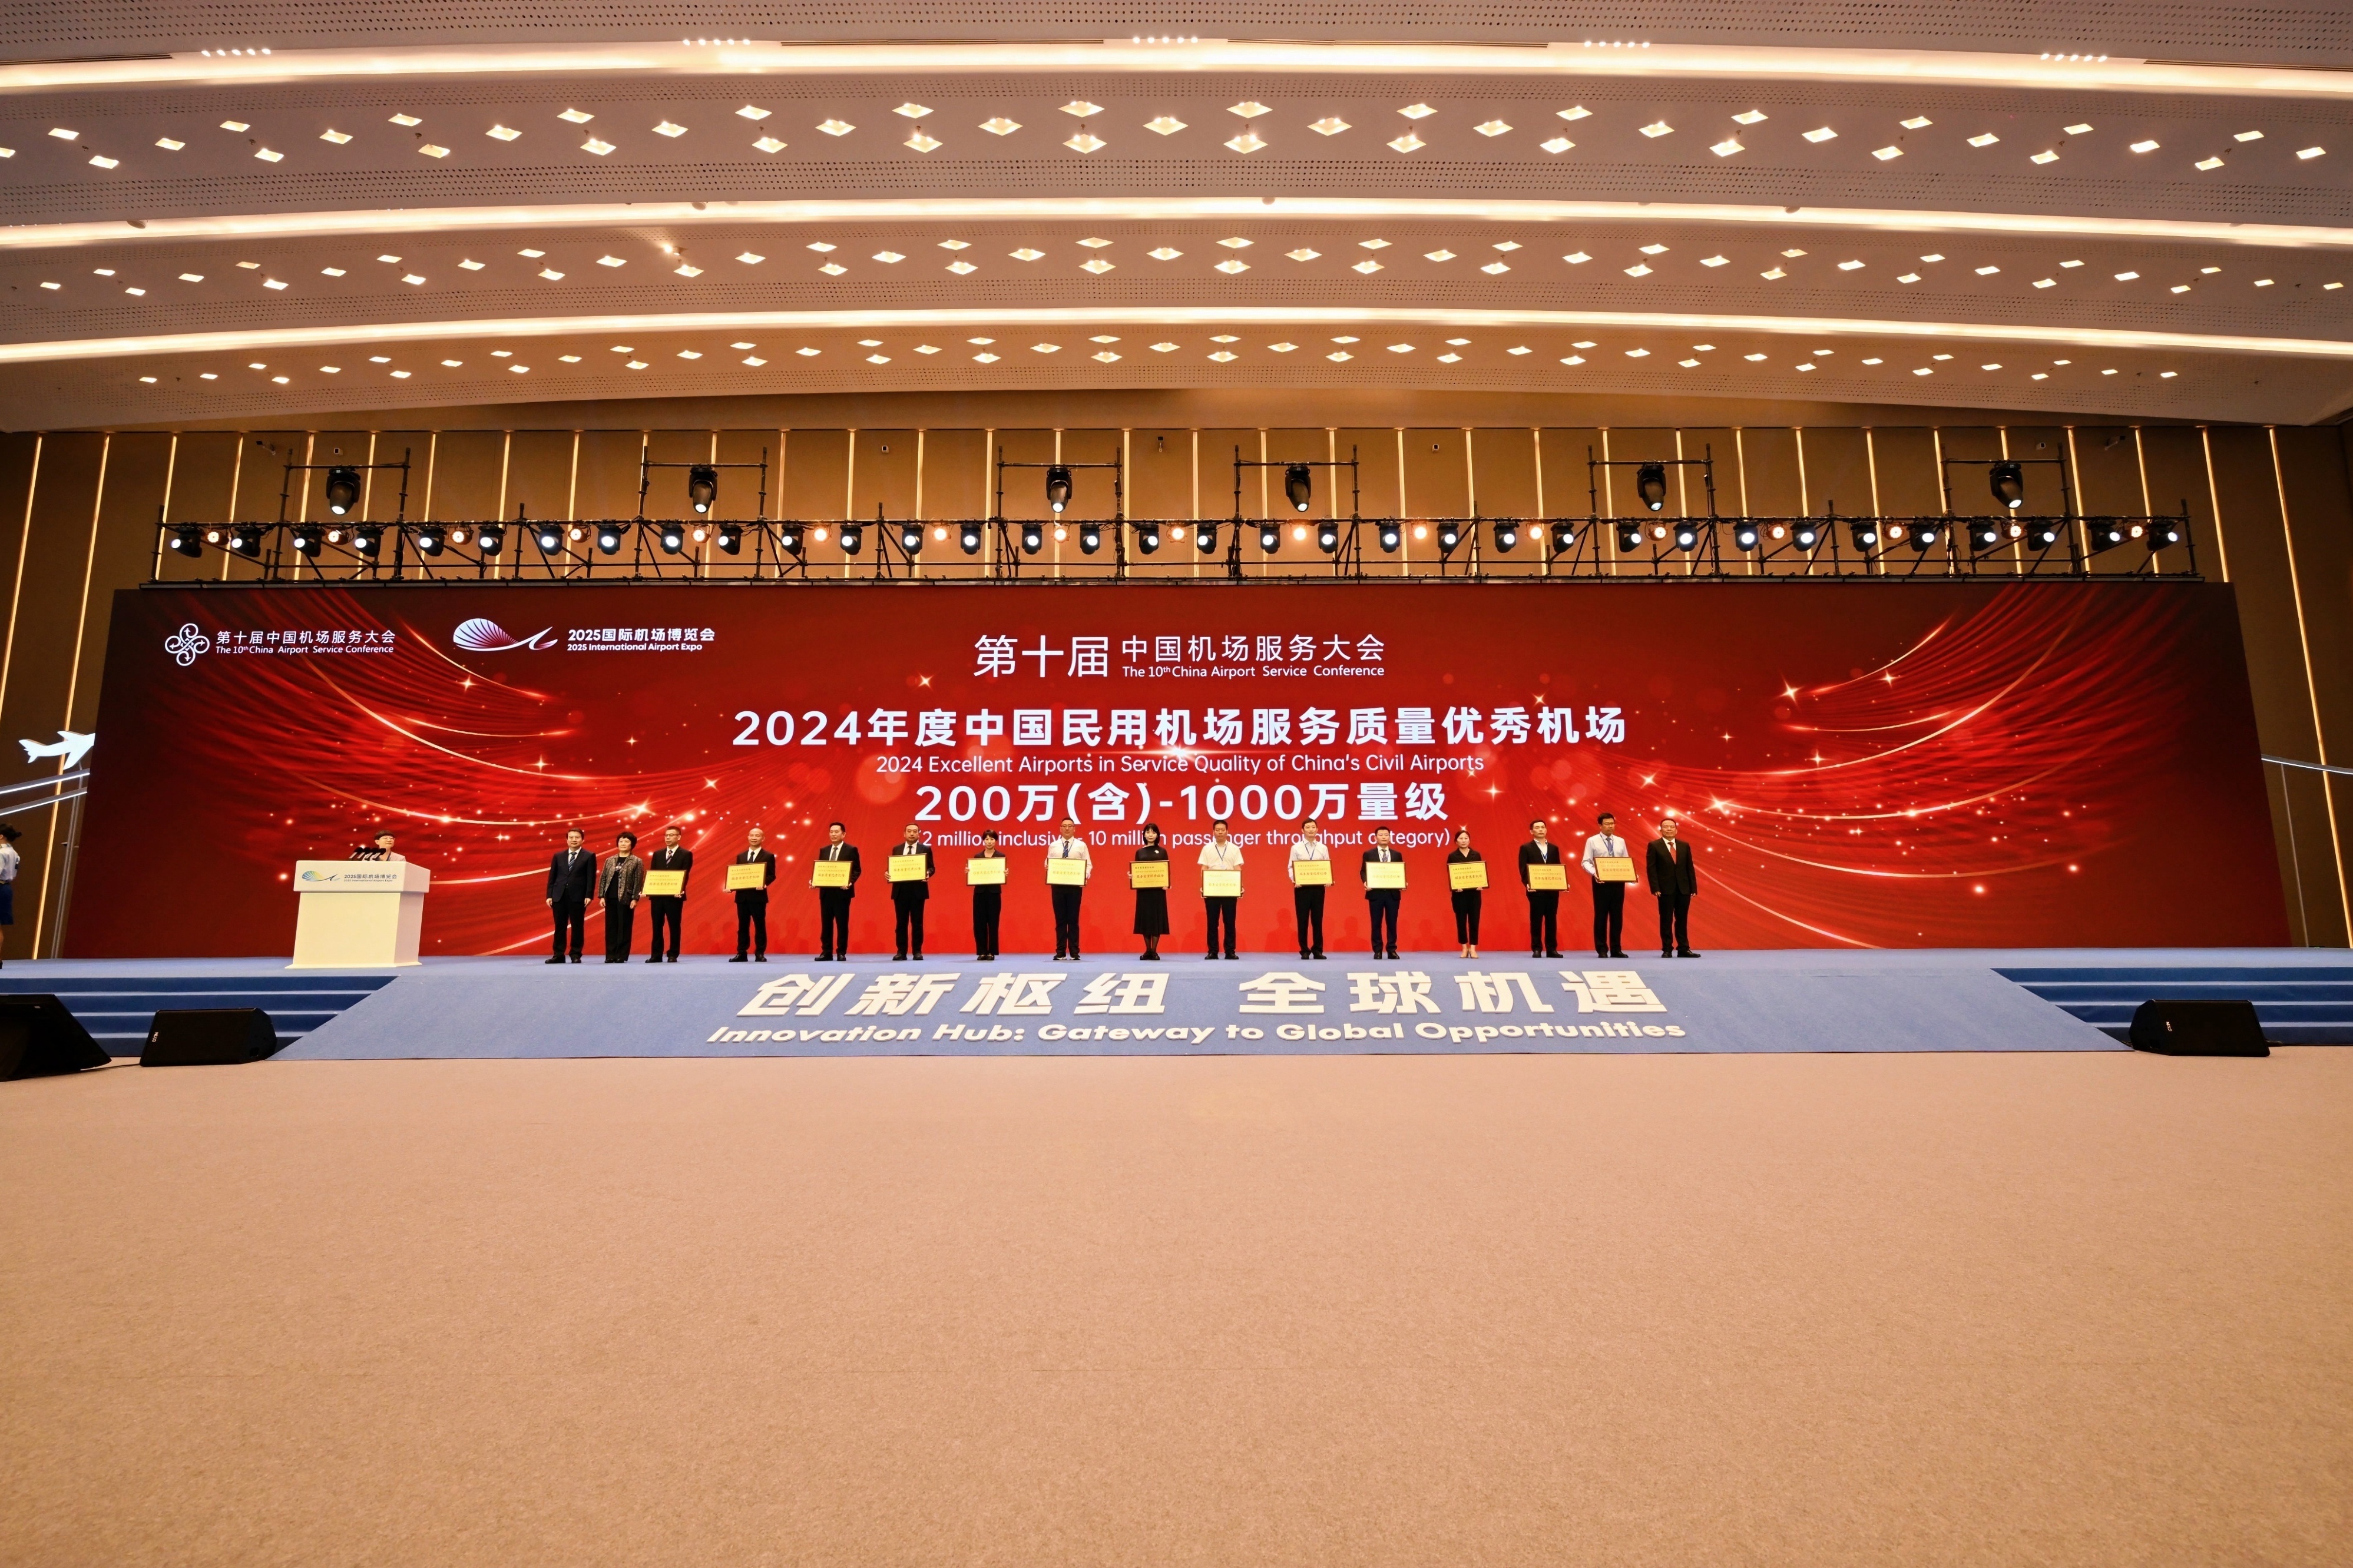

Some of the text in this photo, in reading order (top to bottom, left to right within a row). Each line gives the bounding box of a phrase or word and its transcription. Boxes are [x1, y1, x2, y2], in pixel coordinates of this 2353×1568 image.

[216, 629, 395, 645] 第十届中国机场服务大会
[568, 628, 715, 641] 2025国际机场博览会
[249, 645, 273, 654] China
[277, 645, 309, 655] Airport
[647, 643, 680, 652] Airport
[681, 643, 703, 652] Expo
[973, 634, 1108, 678] 第十届
[1122, 634, 1385, 662] 中国机场服务大会
[1122, 664, 1385, 679] The 10th China Airport Service Conference
[733, 705, 1626, 746] 2024年度中国民用机场服务质量优秀机场
[876, 754, 1484, 776] 2024 Excellent Airports in Service Quality of China's Civil Airports
[938, 830, 987, 846] millio
[1088, 830, 1107, 846] 10
[1111, 830, 1167, 846] millin
[1368, 828, 1450, 848] ctegory)
[736, 971, 1668, 1016] 创新枢纽 全球机遇
[706, 1021, 1687, 1046] Innovation Hub: Gateway to Global Opportunities
